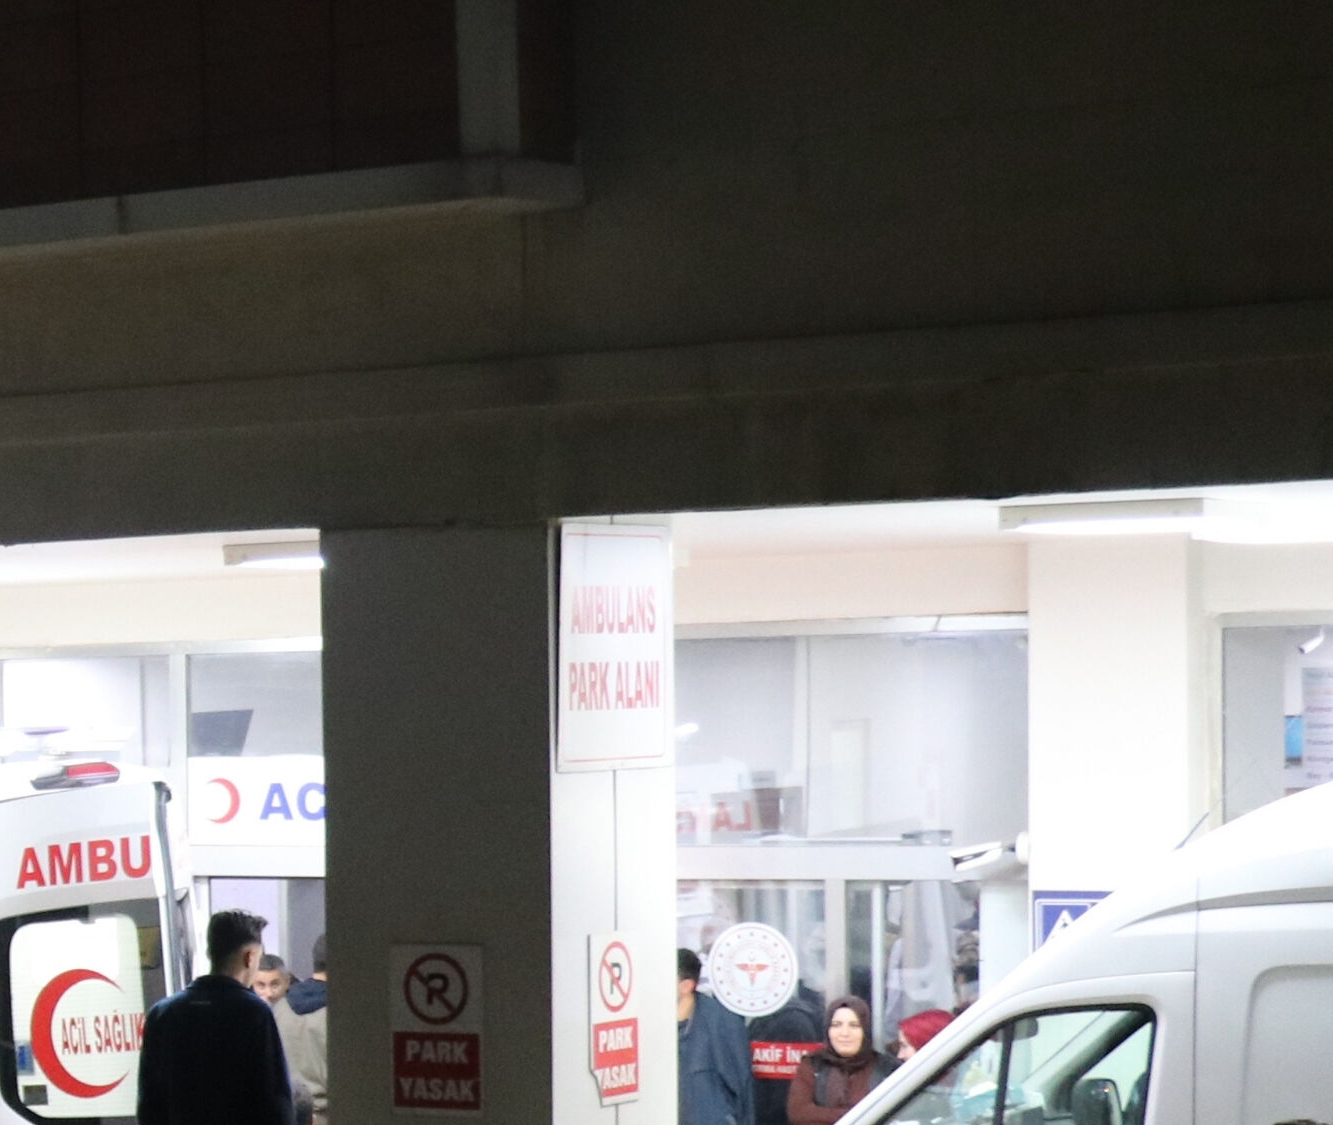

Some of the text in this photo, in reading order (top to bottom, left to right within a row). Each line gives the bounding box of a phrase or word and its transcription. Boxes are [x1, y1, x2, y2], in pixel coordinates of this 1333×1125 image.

[571, 586, 656, 634] AMBULANS
[569, 660, 659, 711] PARK ALANI
[17, 835, 151, 889] AMBU
[94, 1010, 145, 1053] SAĞLIK
[598, 1026, 633, 1053] PARK
[405, 1039, 469, 1064] PARK
[399, 1077, 476, 1101] YASAK
[594, 1063, 636, 1090] YASAK
